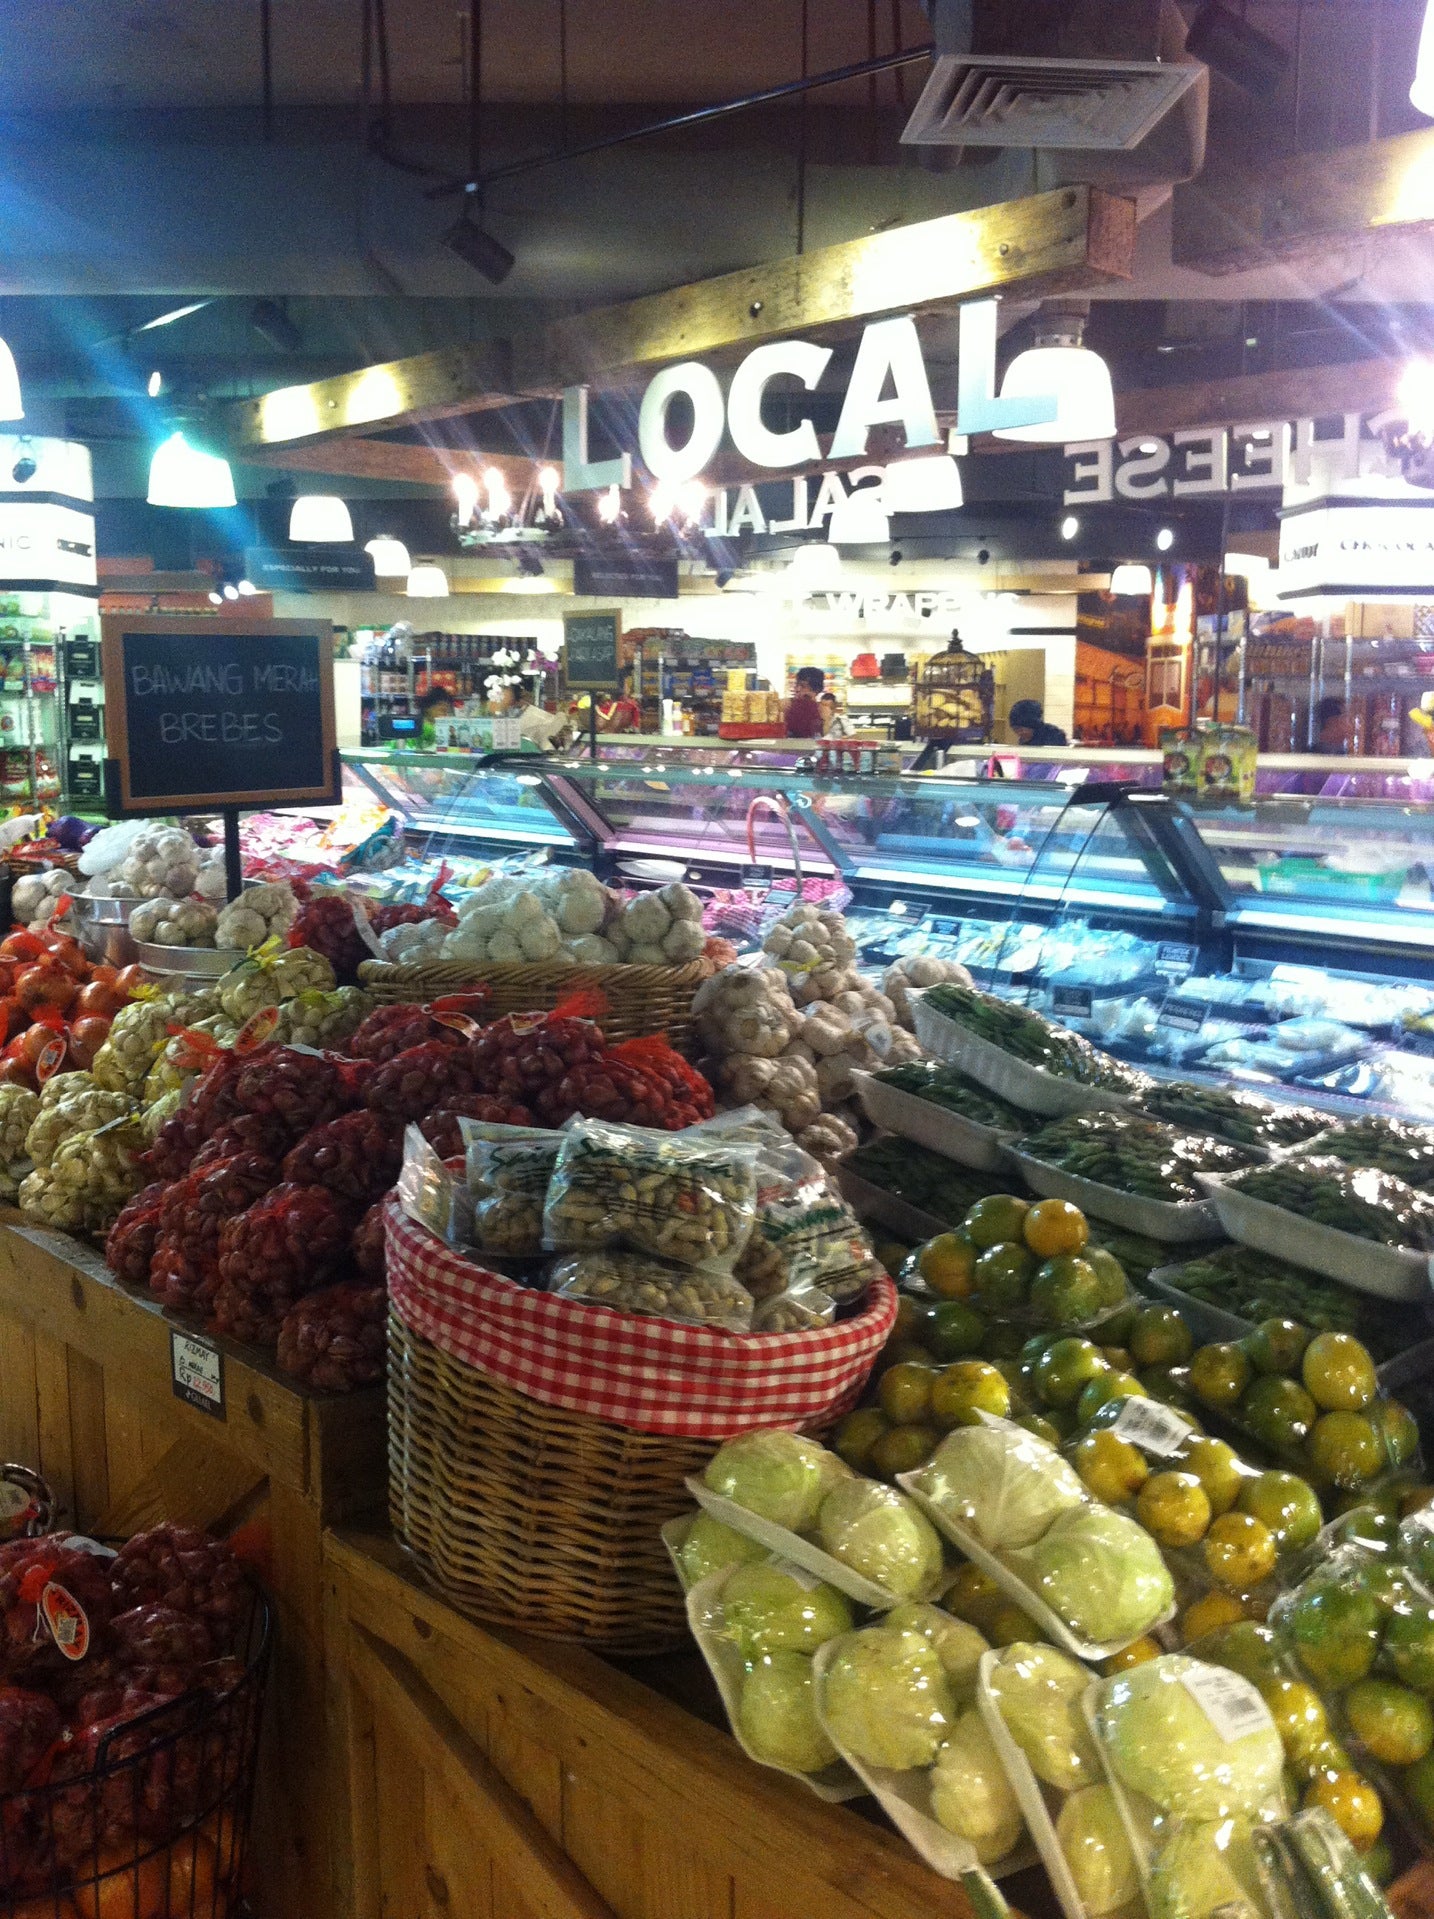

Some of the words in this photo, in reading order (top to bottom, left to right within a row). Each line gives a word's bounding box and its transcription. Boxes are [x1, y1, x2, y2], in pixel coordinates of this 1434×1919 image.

[562, 296, 1058, 492] LOCAL
[131, 663, 243, 696] BAWANG
[160, 711, 284, 744] BREBES
